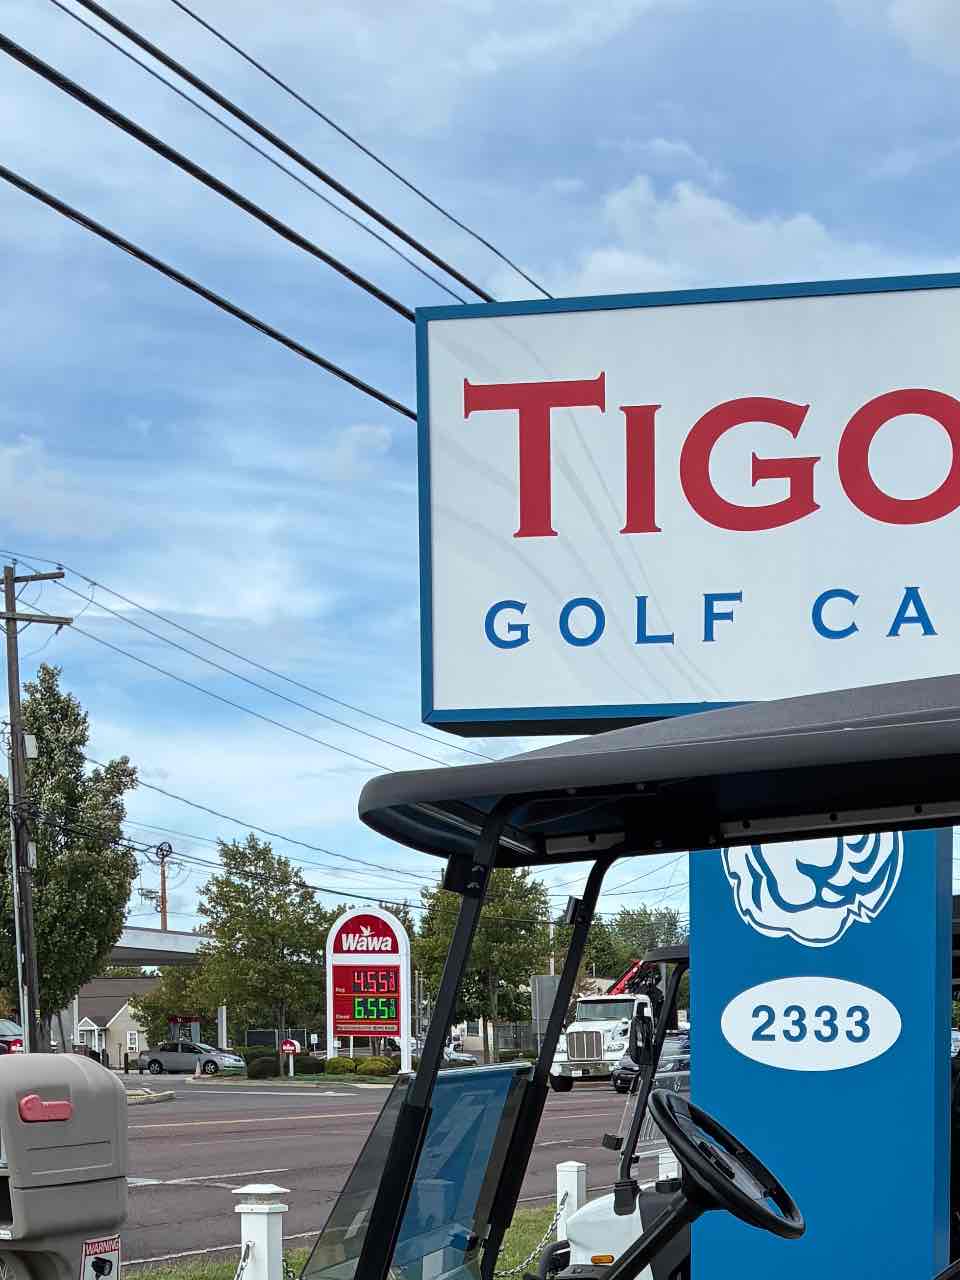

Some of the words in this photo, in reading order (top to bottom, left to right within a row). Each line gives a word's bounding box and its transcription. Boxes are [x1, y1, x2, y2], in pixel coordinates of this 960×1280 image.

[484, 591, 743, 649] GOLF
[342, 933, 392, 951] Wawa
[751, 1004, 870, 1043] 2333
[85, 1238, 120, 1255] WARNING
